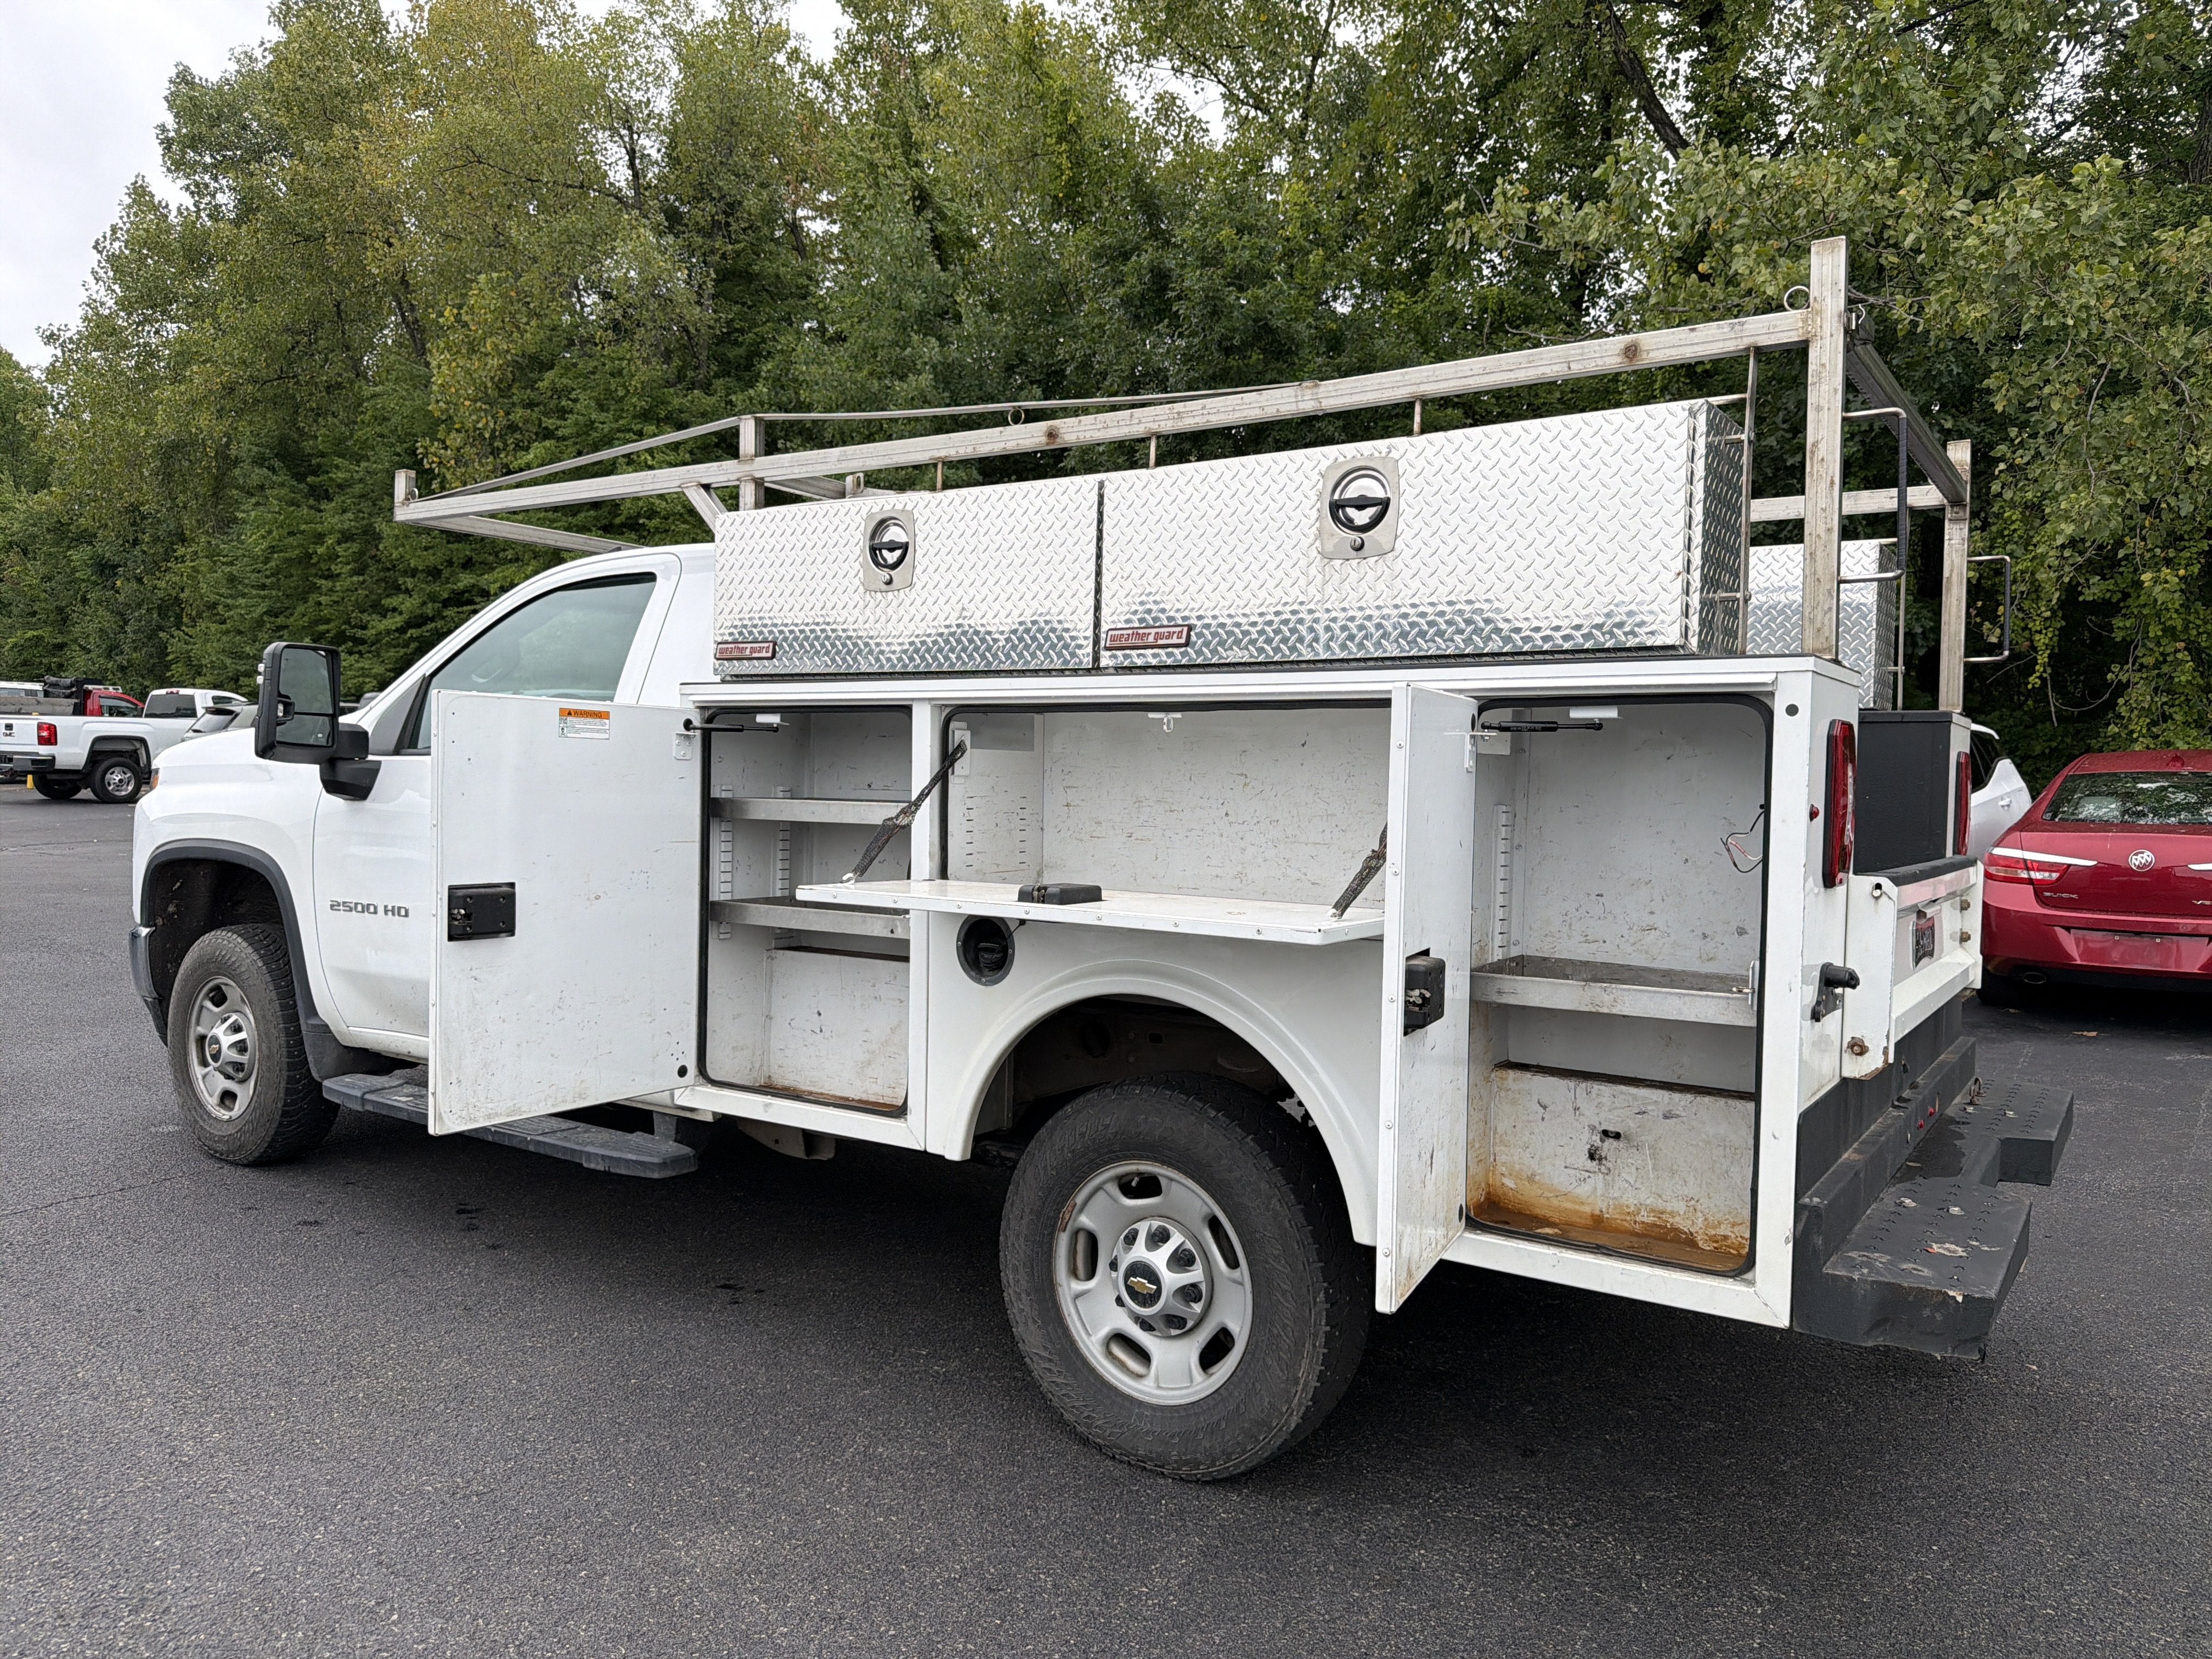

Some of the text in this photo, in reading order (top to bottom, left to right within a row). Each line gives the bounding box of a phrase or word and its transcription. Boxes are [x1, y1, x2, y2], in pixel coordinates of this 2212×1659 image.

[1109, 628, 1183, 642] weather guard
[718, 645, 770, 655] weather guard
[573, 710, 602, 718] WARNING
[330, 900, 409, 917] 2500 HD
